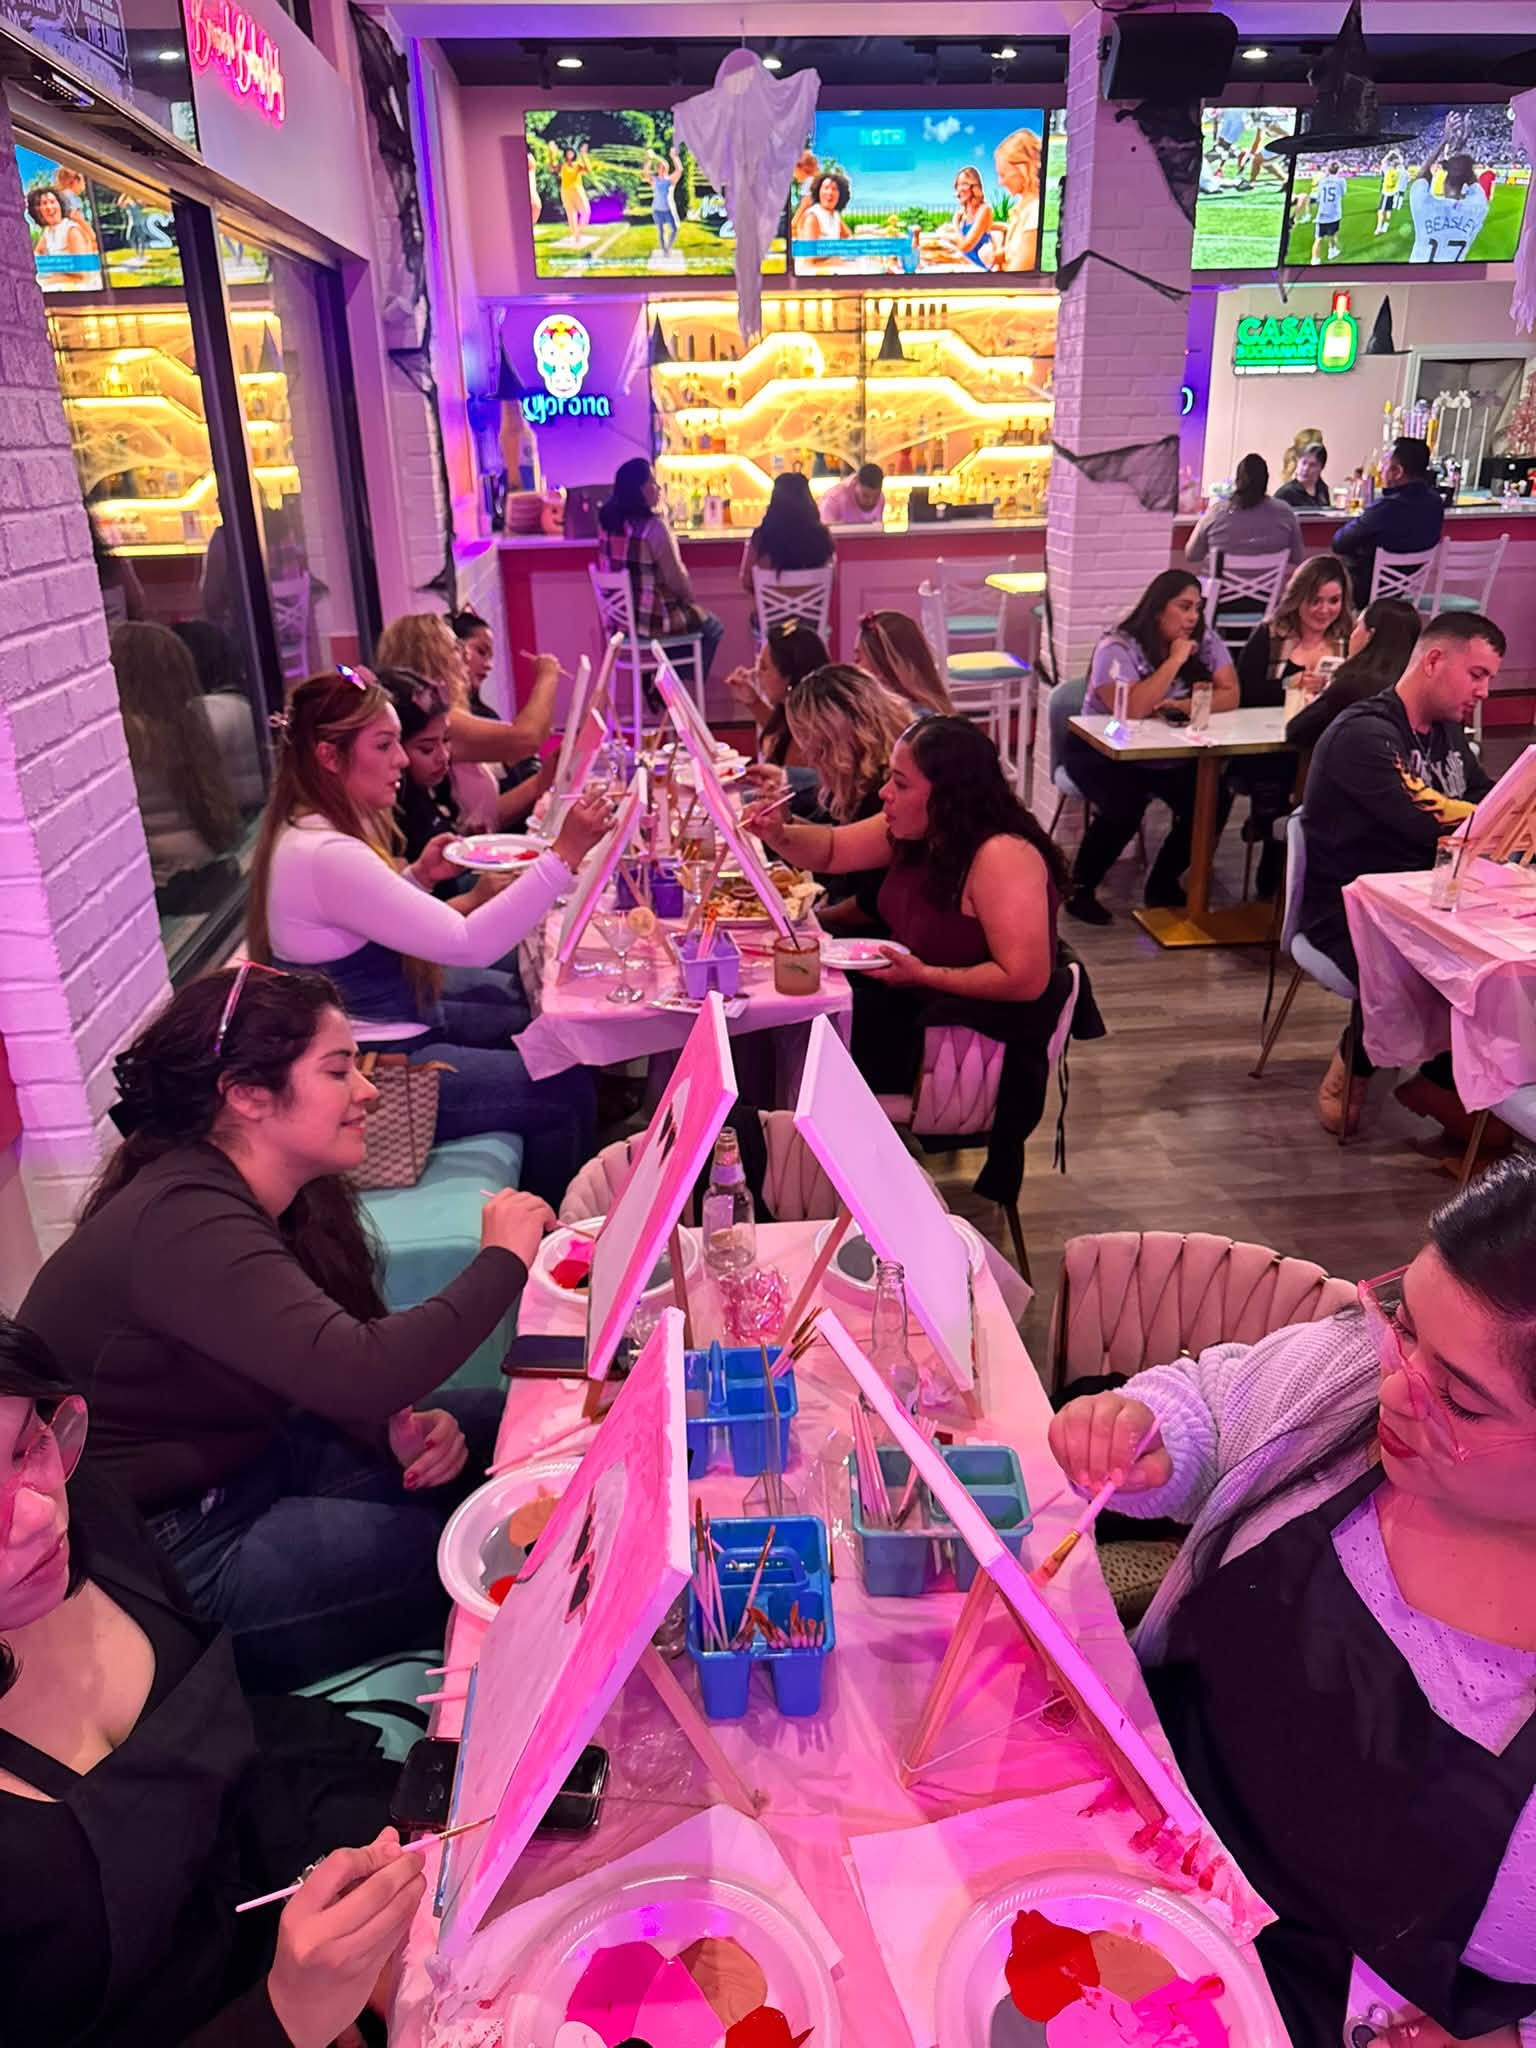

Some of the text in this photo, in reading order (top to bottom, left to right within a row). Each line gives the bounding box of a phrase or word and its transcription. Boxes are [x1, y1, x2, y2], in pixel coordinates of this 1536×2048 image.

[1322, 186, 1337, 203] 15
[1428, 238, 1467, 262] 17
[1237, 315, 1319, 345] CASA
[522, 394, 610, 424] Corona
